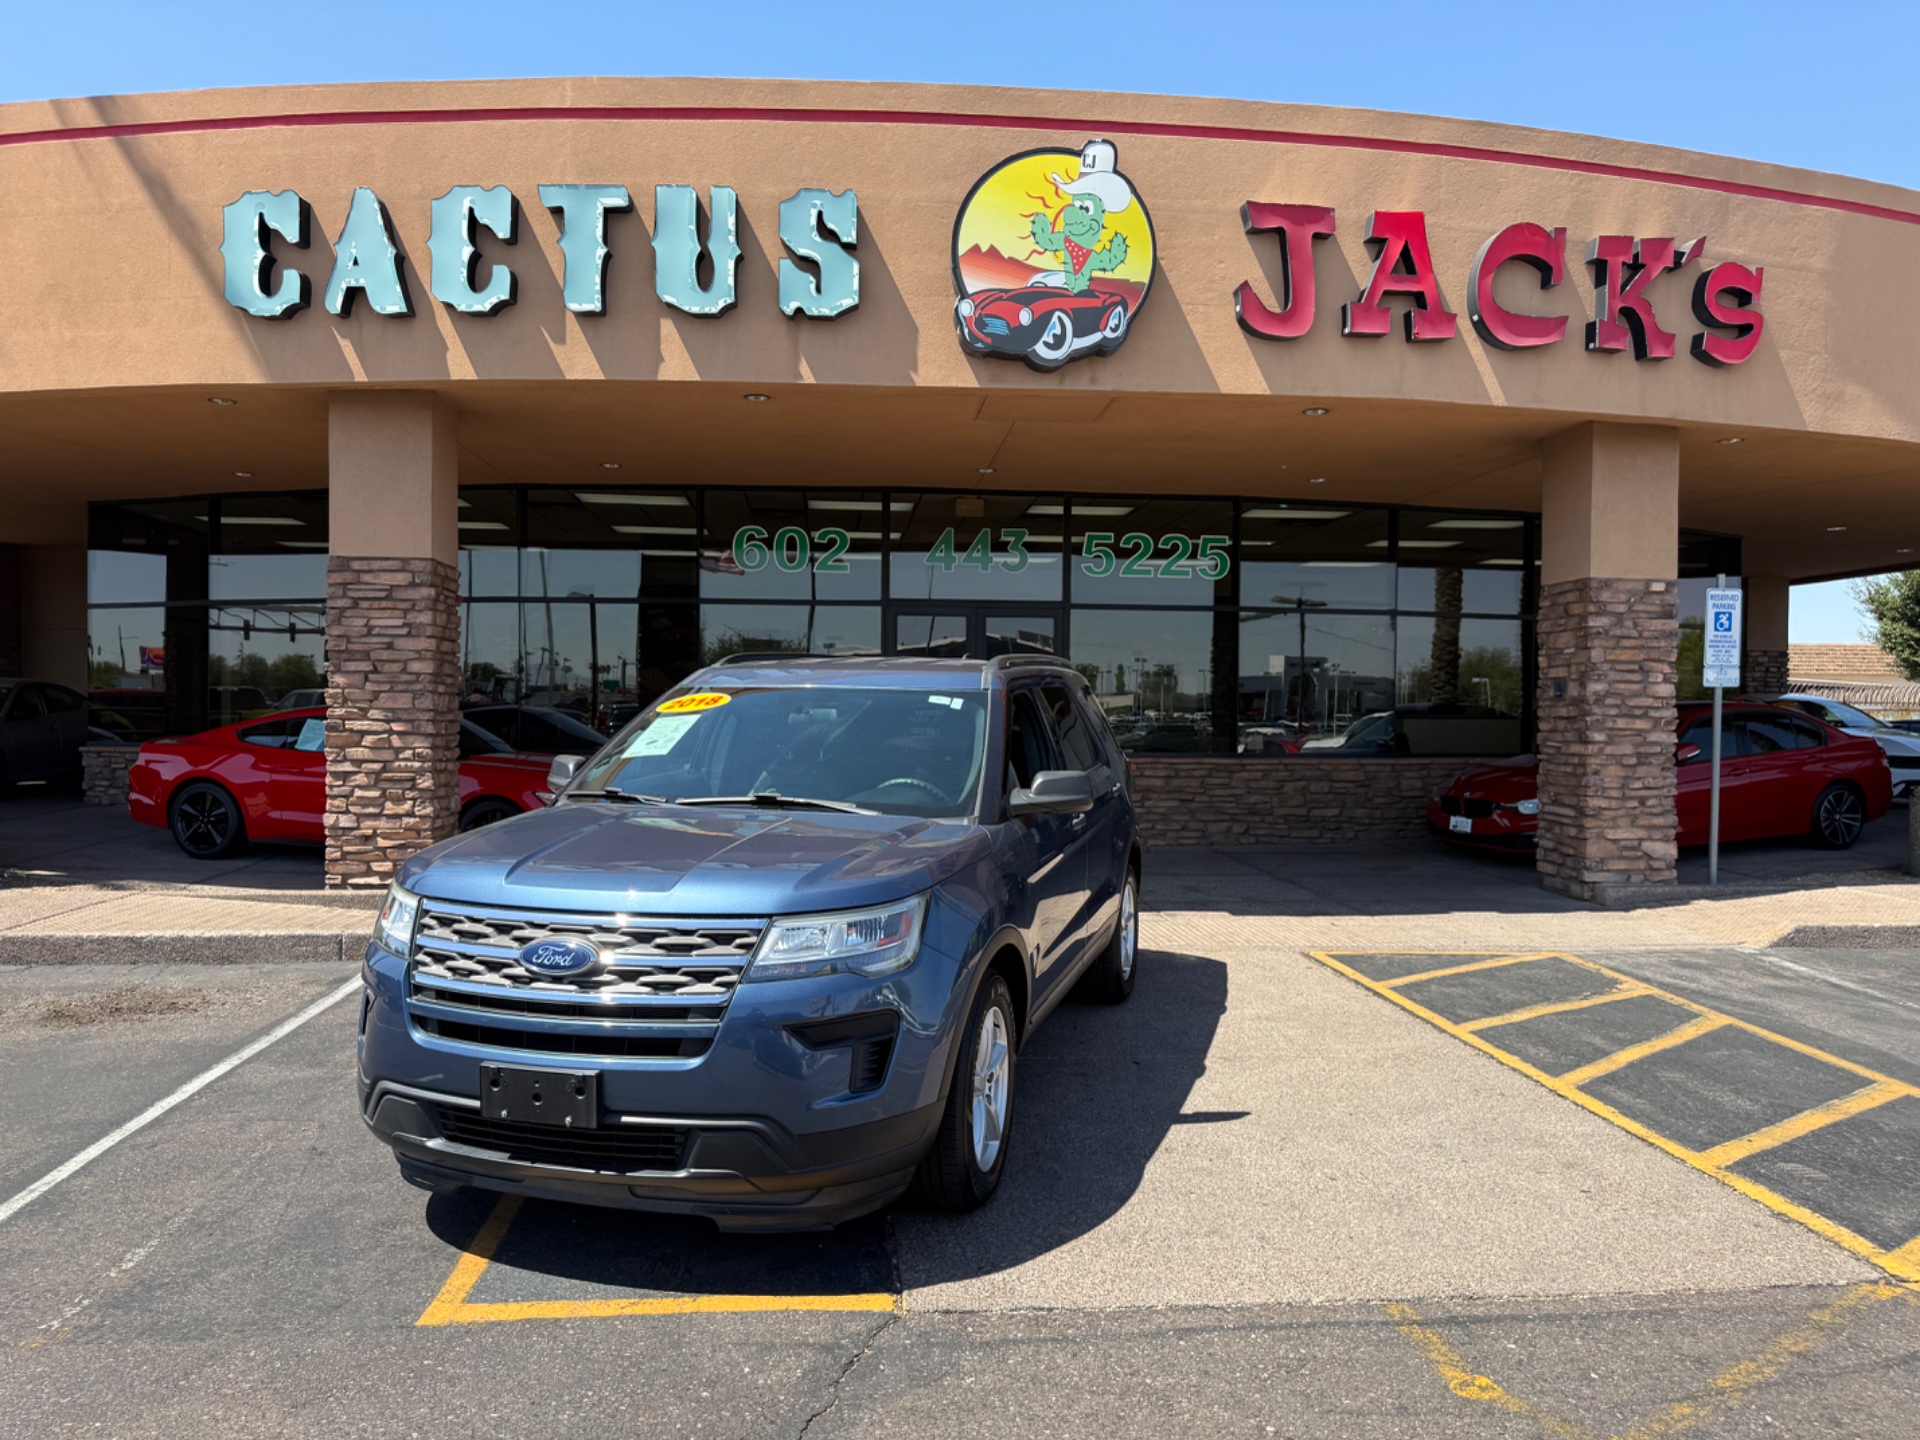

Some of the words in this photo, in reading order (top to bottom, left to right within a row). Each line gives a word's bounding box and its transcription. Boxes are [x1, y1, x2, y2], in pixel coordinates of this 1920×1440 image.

[220, 184, 860, 318] CACTUS
[1234, 200, 1764, 366] JACK'S
[732, 525, 851, 573] 602
[924, 527, 1030, 573] 443
[1080, 532, 1231, 580] 5225
[1709, 593, 1739, 602] RESERVED
[1711, 602, 1737, 611] PARKING
[532, 945, 576, 966] Ford
